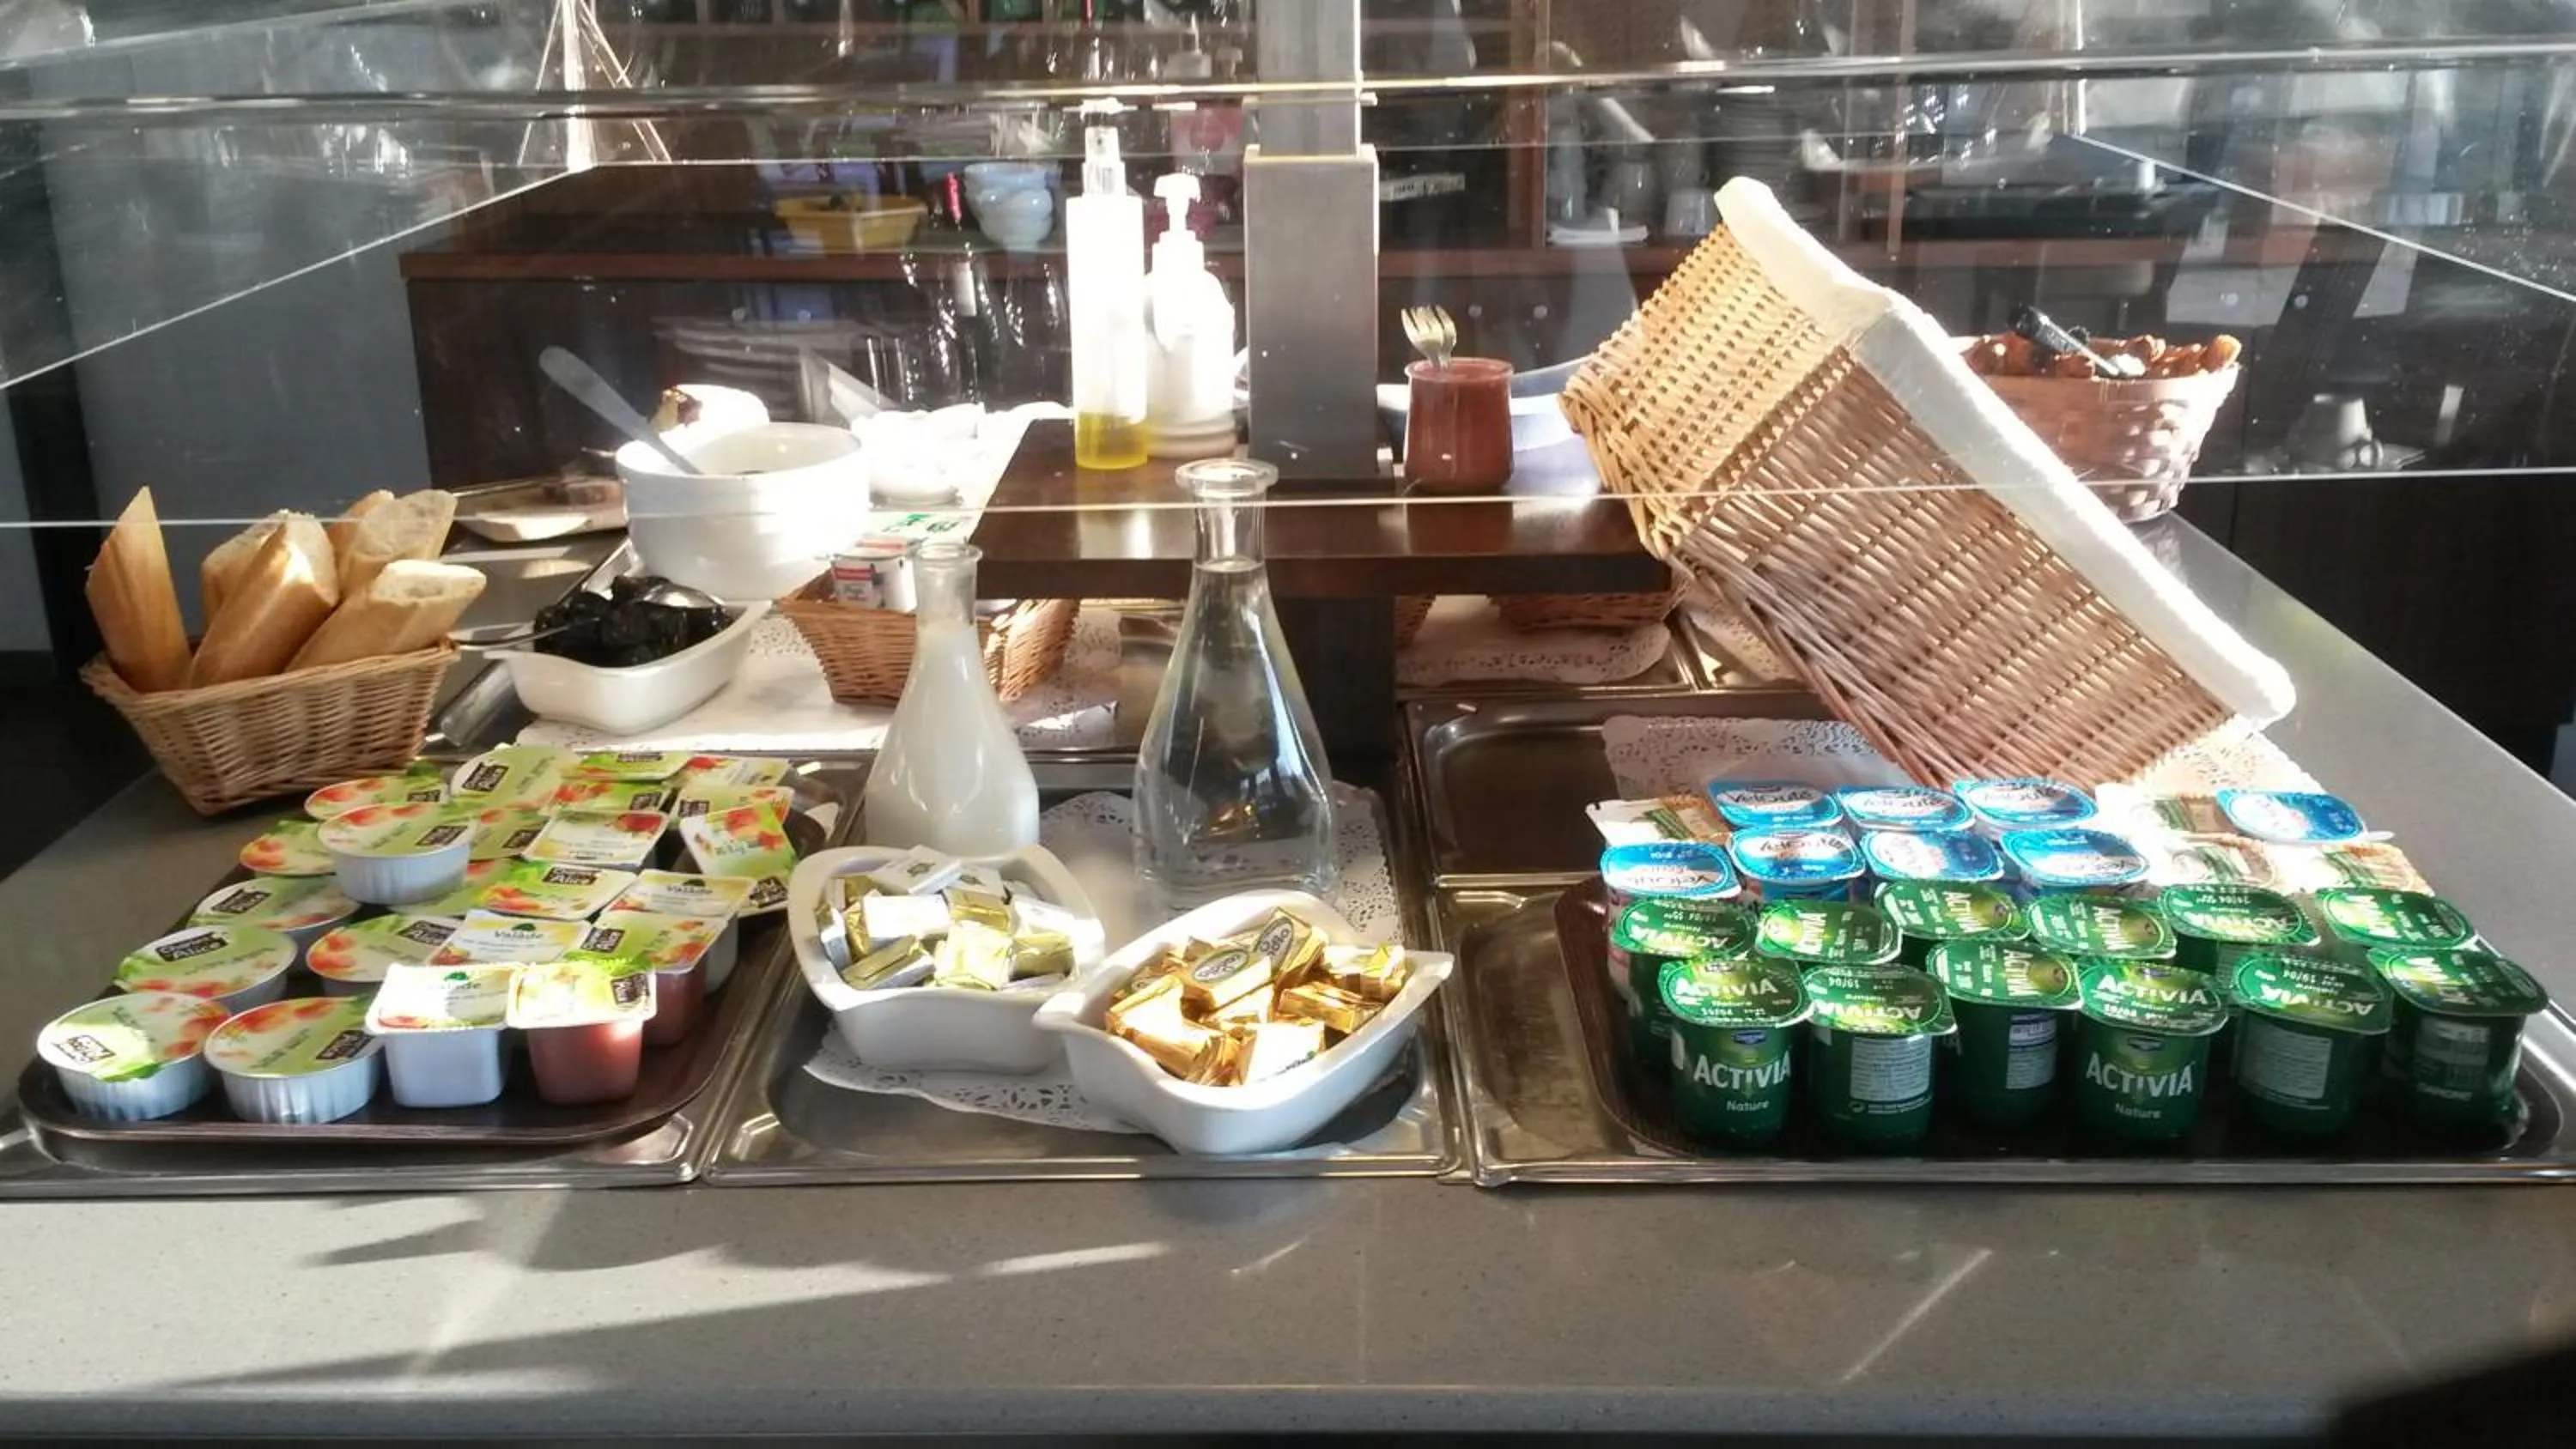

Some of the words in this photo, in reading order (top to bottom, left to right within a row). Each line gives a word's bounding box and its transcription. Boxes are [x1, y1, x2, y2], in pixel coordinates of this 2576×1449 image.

[1674, 977, 1779, 998] ACTIVIA
[2096, 974, 2209, 1005] ACTIVIA
[2260, 984, 2376, 1016] ACTIVIA
[1814, 998, 1923, 1021] ACTIVIA
[1692, 1050, 1791, 1089] ACTIVIA
[2085, 1051, 2194, 1098] ACTIVIA
[1726, 1100, 1770, 1113] Nature
[2115, 1102, 2163, 1119] Nature
